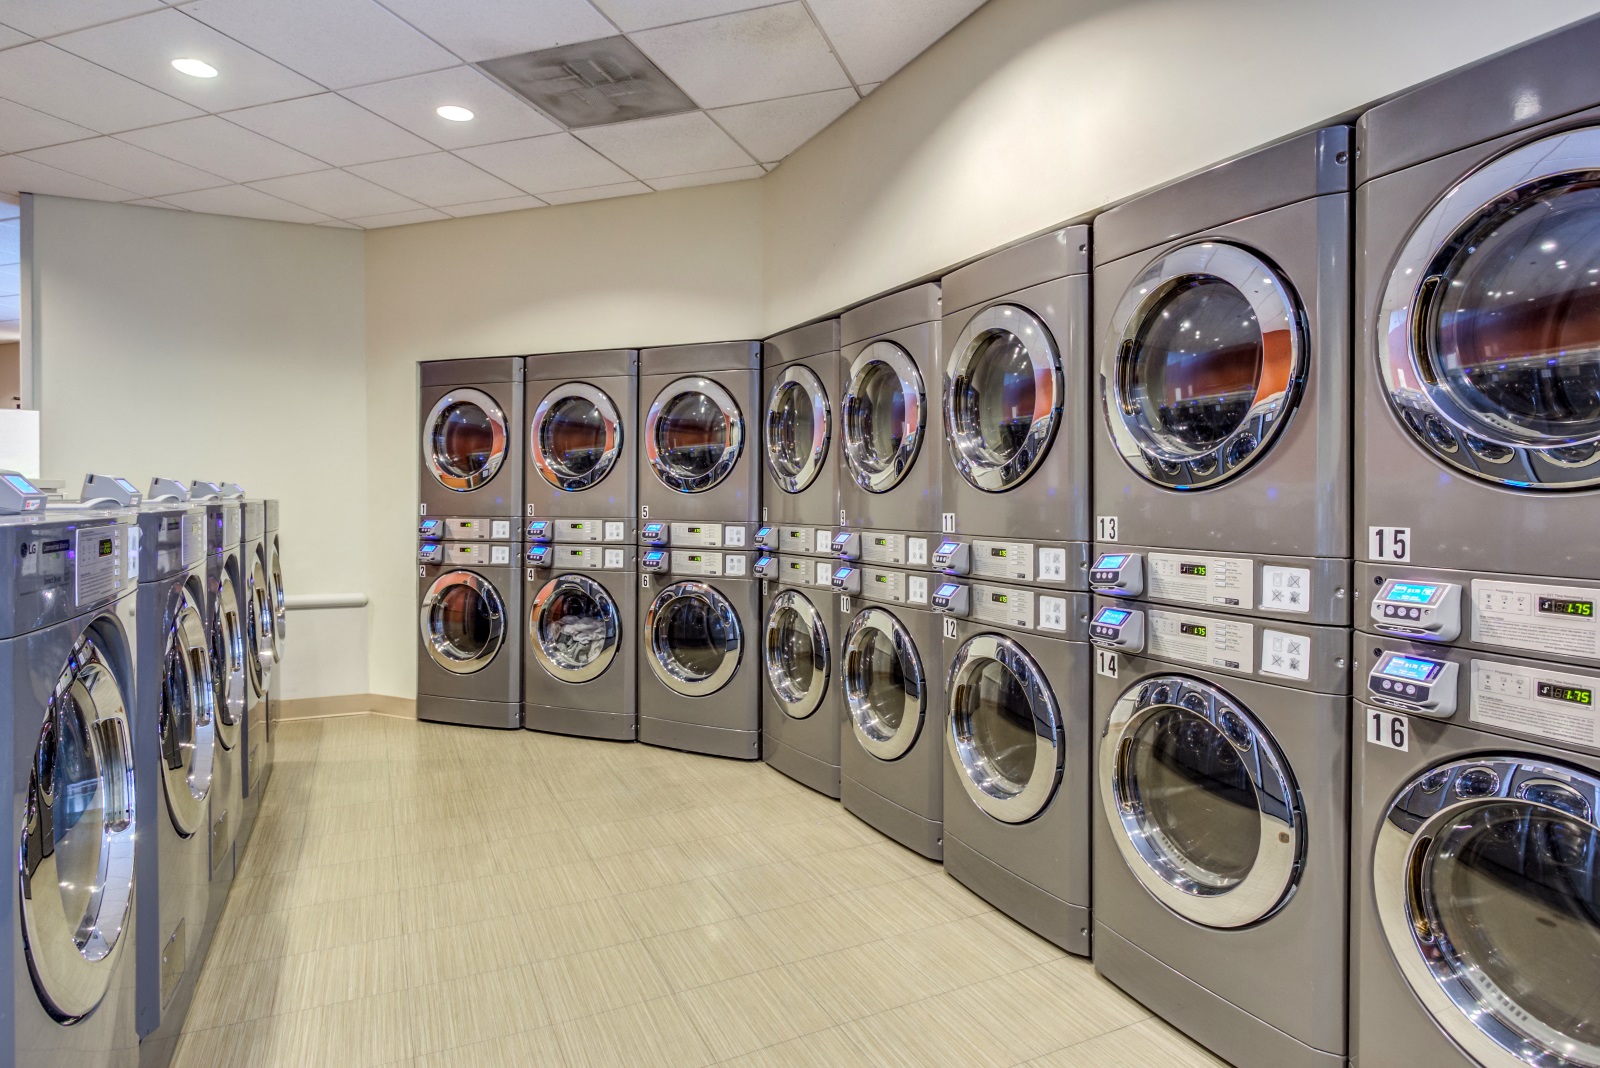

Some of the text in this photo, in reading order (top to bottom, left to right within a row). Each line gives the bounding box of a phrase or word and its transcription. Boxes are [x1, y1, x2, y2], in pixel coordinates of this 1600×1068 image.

[643, 506, 648, 518] 5
[944, 515, 953, 531] 11
[1100, 518, 1116, 539] 13
[28, 544, 37, 554] LG
[1375, 529, 1406, 559] 15
[643, 575, 648, 586] 6
[842, 597, 849, 612] 10
[1567, 603, 1591, 615] 1.75
[945, 619, 956, 637] 12
[1100, 652, 1117, 677] 14
[1566, 690, 1590, 703] 1.75
[1373, 713, 1405, 748] 16
